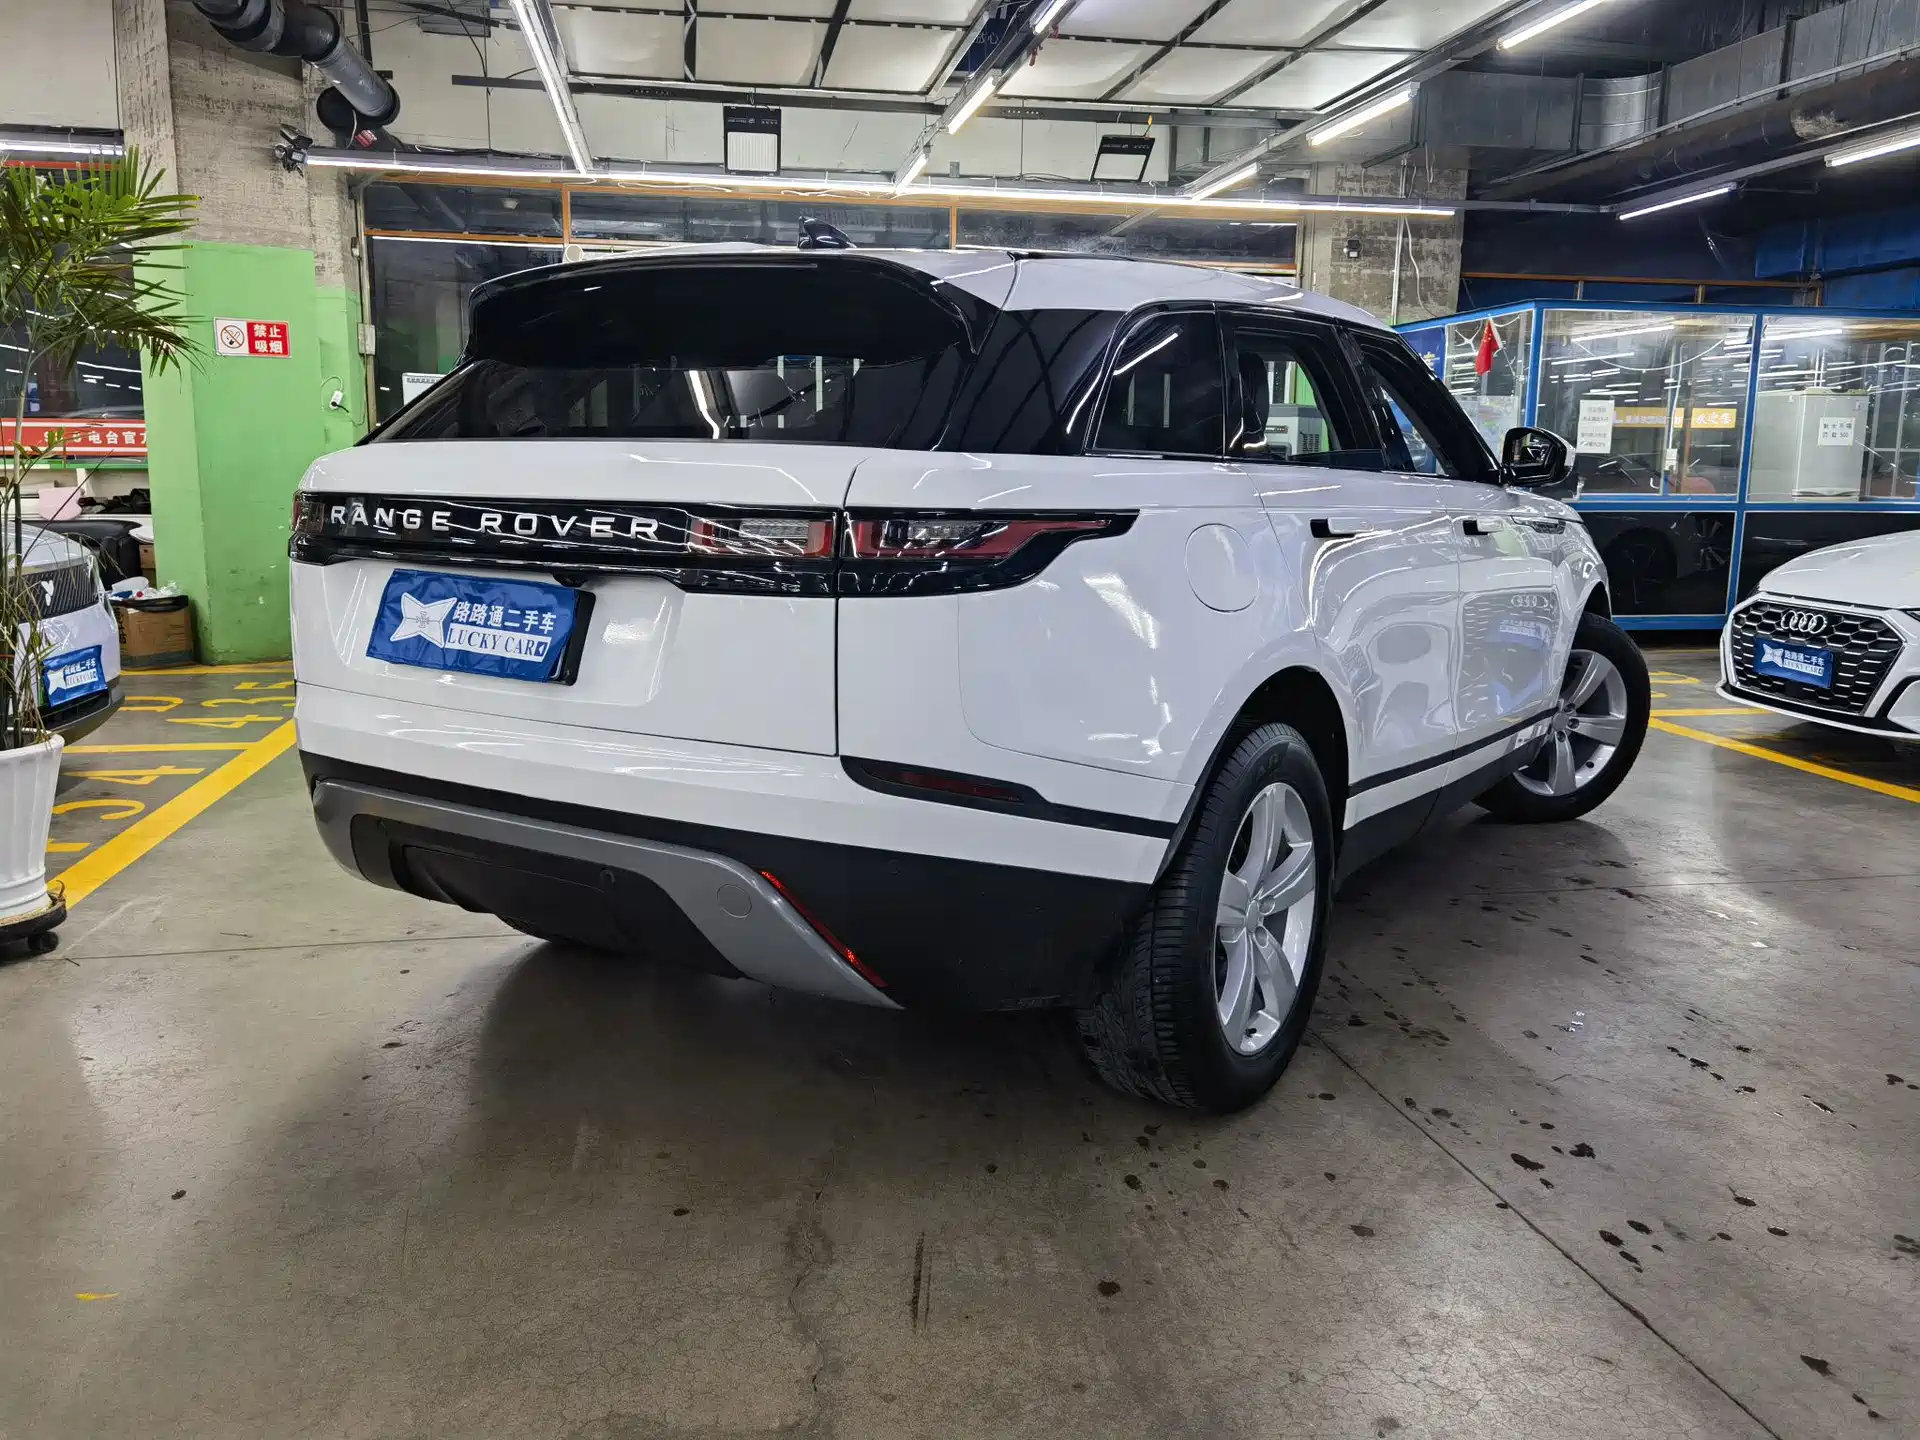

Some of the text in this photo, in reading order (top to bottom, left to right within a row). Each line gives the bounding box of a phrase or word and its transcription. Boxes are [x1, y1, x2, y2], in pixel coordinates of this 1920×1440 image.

[253, 323, 282, 338] 禁止
[254, 339, 284, 353] 吸烟
[330, 504, 659, 541] RANGE ROVER
[452, 601, 557, 635] 路路通二手车
[447, 628, 535, 657] LUCKY CAR
